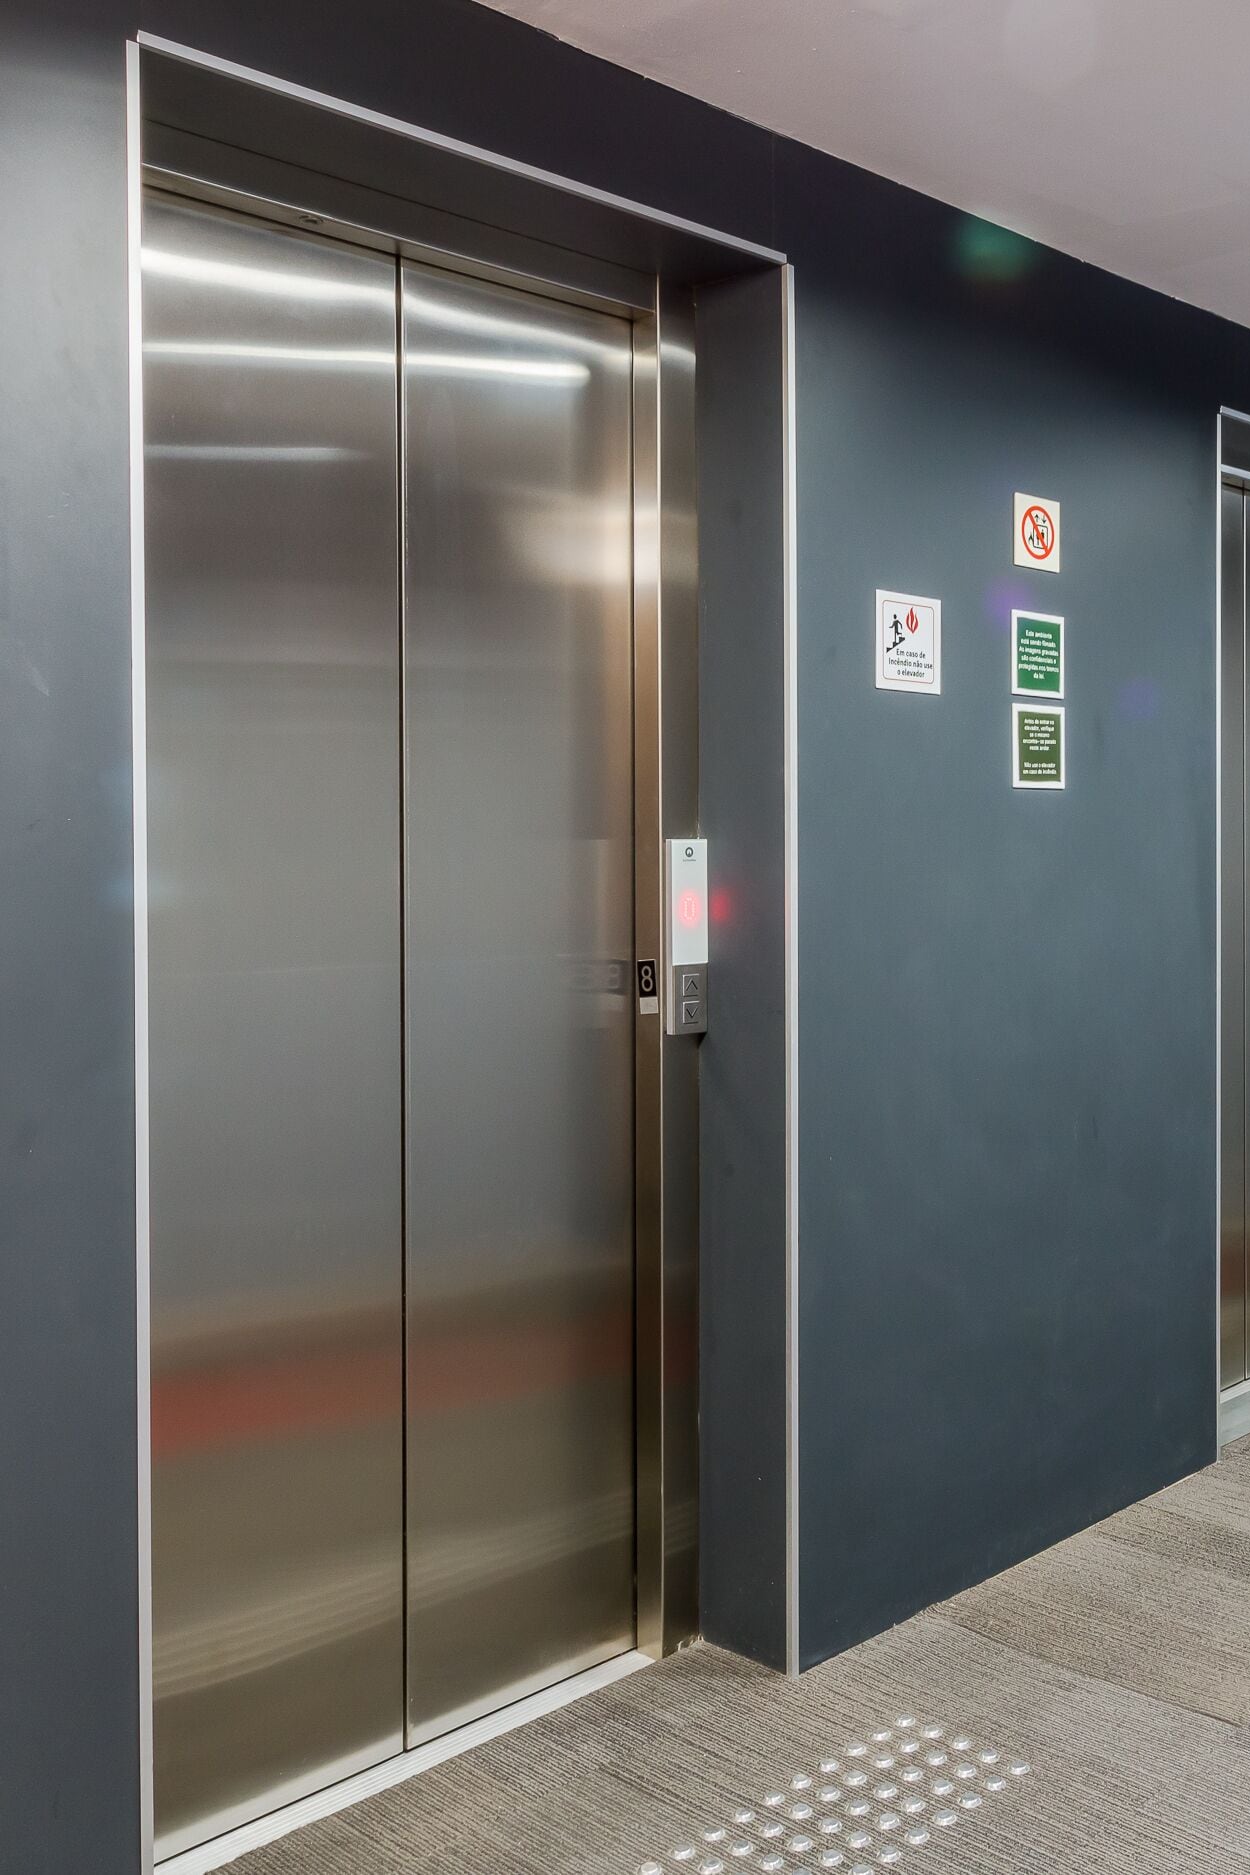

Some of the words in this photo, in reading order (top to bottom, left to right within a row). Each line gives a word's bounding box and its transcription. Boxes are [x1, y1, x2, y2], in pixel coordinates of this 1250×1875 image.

[896, 648, 905, 656] Em
[906, 650, 918, 658] caso
[919, 651, 926, 659] de
[913, 660, 923, 668] não
[924, 662, 933, 670] use
[902, 668, 925, 678] elevador
[641, 965, 653, 992] 8
